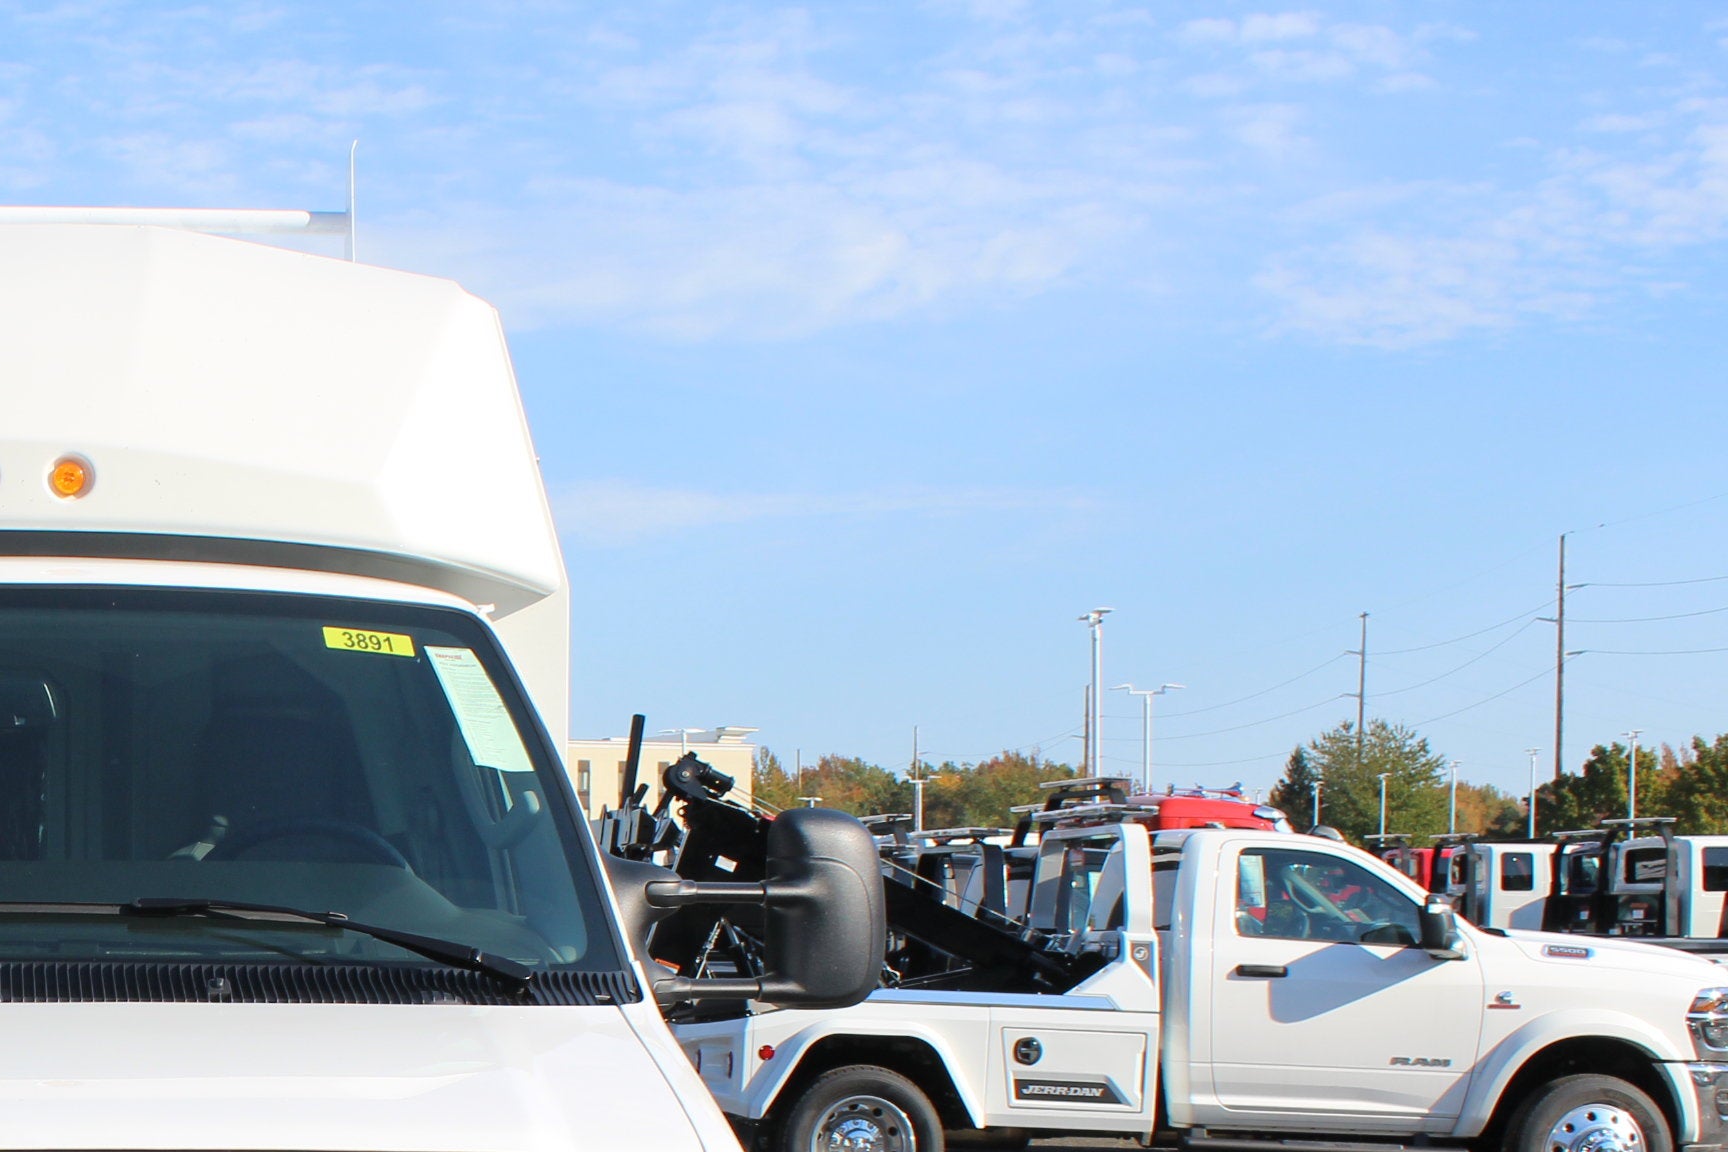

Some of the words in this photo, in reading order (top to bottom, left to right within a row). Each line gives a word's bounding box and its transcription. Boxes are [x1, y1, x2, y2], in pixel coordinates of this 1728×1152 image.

[341, 631, 394, 653] 3891
[1389, 1056, 1452, 1068] RAM
[1021, 1084, 1105, 1097] JERR-DAN
